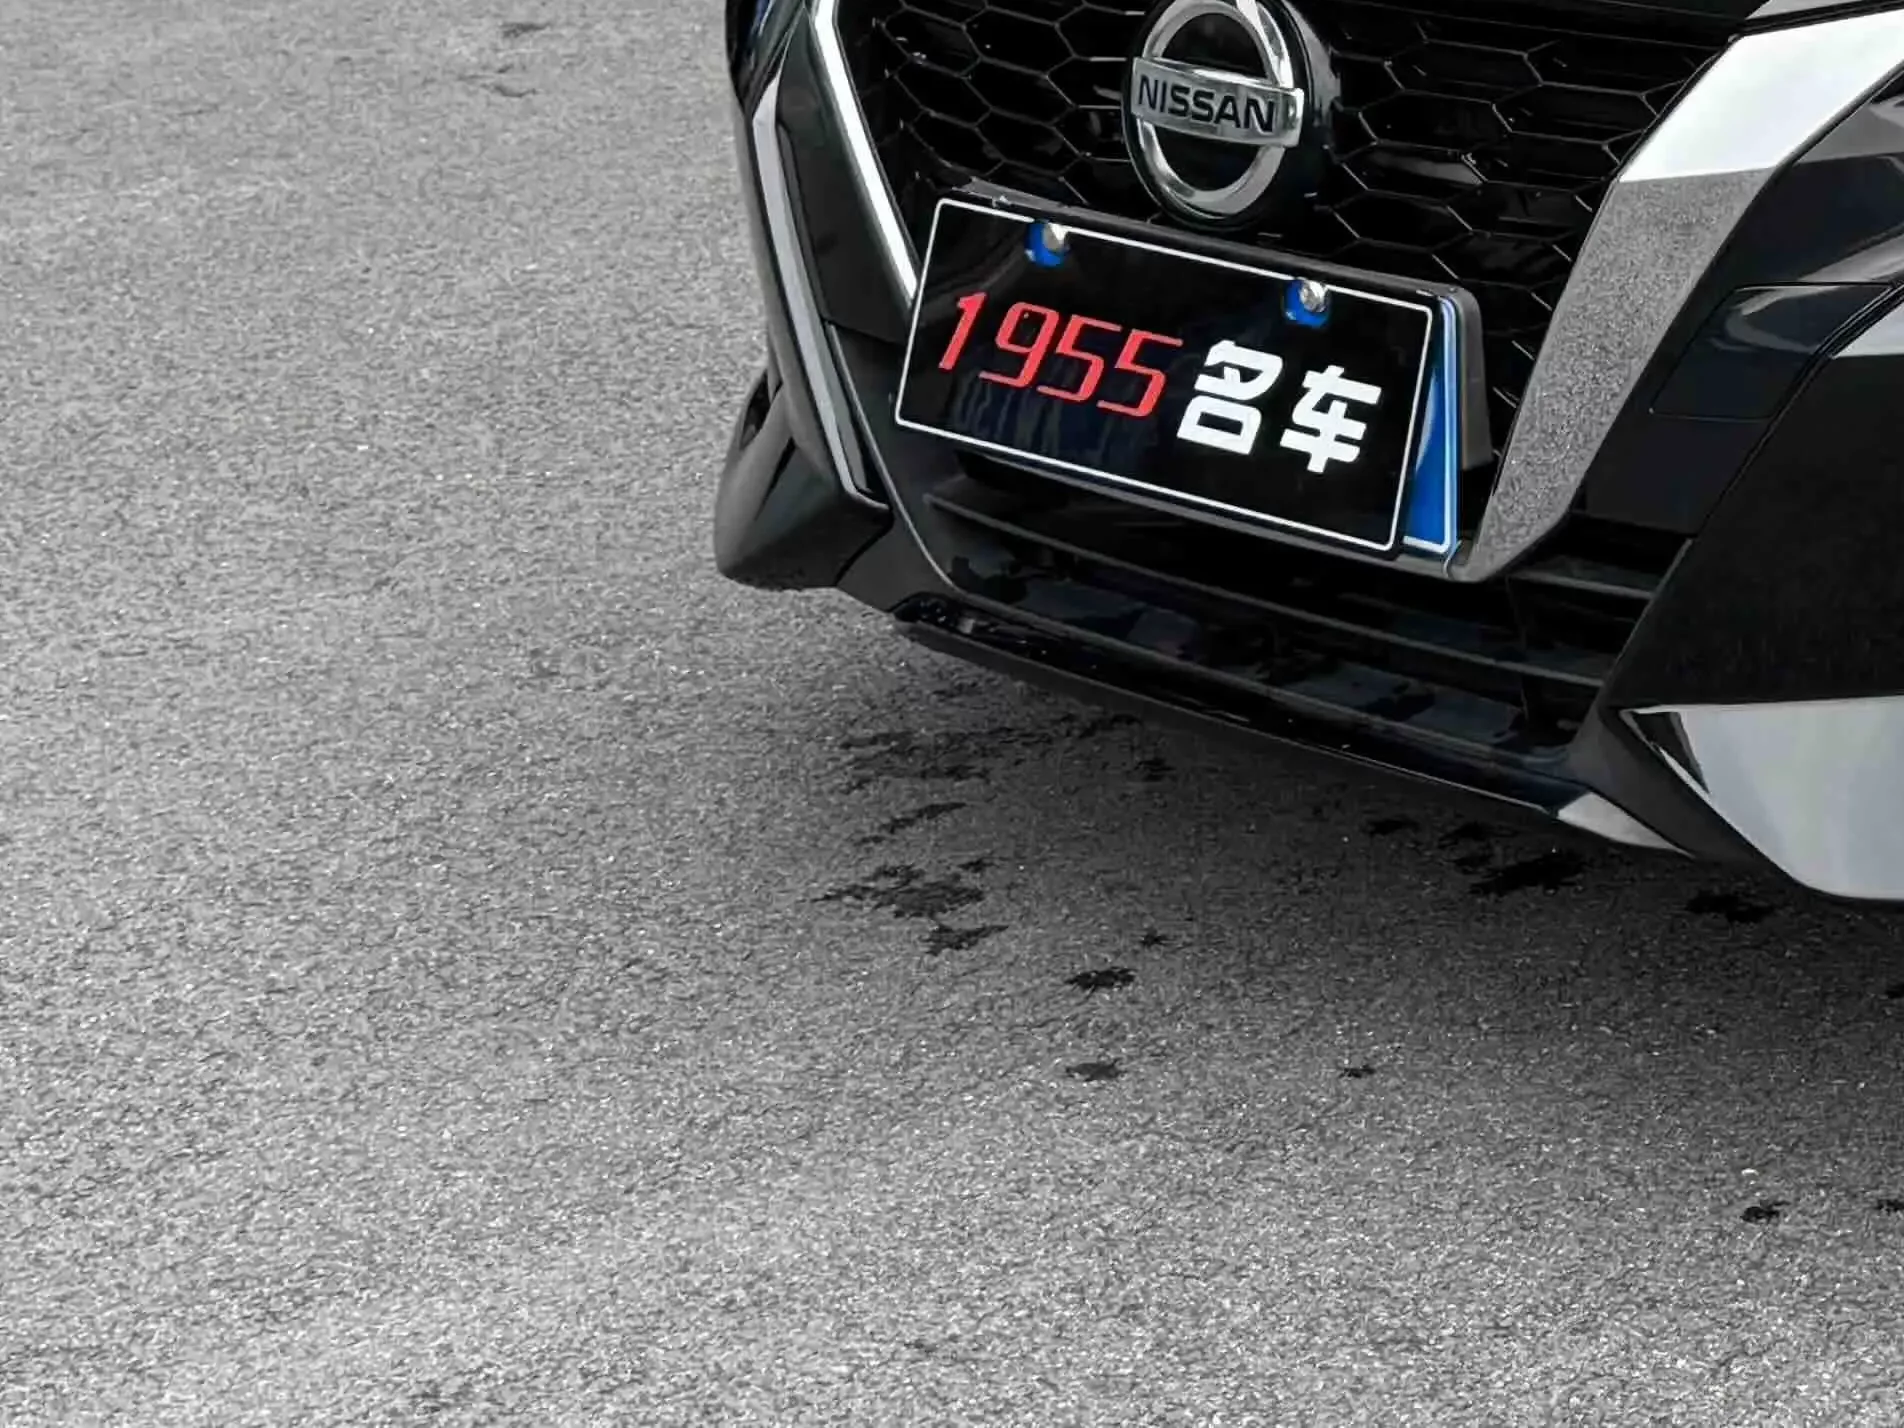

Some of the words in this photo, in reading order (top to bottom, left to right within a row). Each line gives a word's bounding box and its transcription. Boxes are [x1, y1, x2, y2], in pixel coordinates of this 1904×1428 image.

[1138, 74, 1276, 133] NISSAN
[937, 291, 1184, 418] 1955
[1176, 339, 1382, 474] 名车
